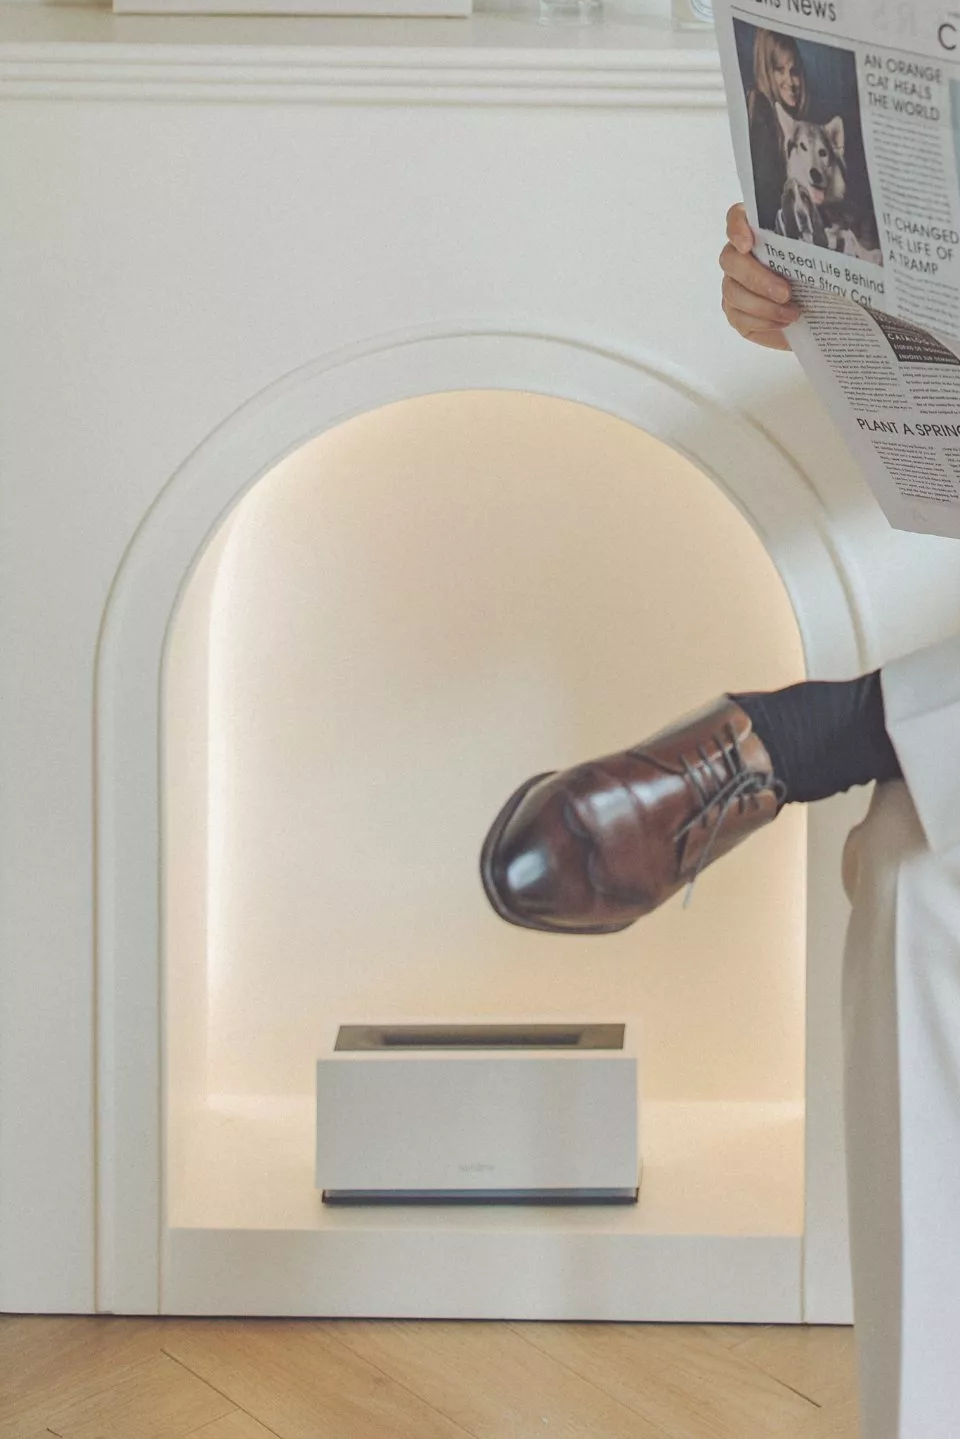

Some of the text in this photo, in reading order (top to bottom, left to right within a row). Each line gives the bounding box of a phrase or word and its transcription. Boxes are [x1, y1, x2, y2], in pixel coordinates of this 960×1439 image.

[864, 53, 942, 84] AN ORANGE
[866, 72, 932, 101] CAT HEALS
[867, 91, 940, 121] THE WORLD
[882, 212, 960, 245] IT CHANGED
[886, 230, 954, 262] THE LIFE OF
[764, 242, 885, 295] The Real Life Behind
[888, 251, 939, 276] A TRAMP
[794, 267, 816, 286] The
[818, 276, 848, 299] Stray
[850, 288, 873, 308] Cat
[857, 418, 899, 435] PLANT
[903, 423, 914, 437] A
